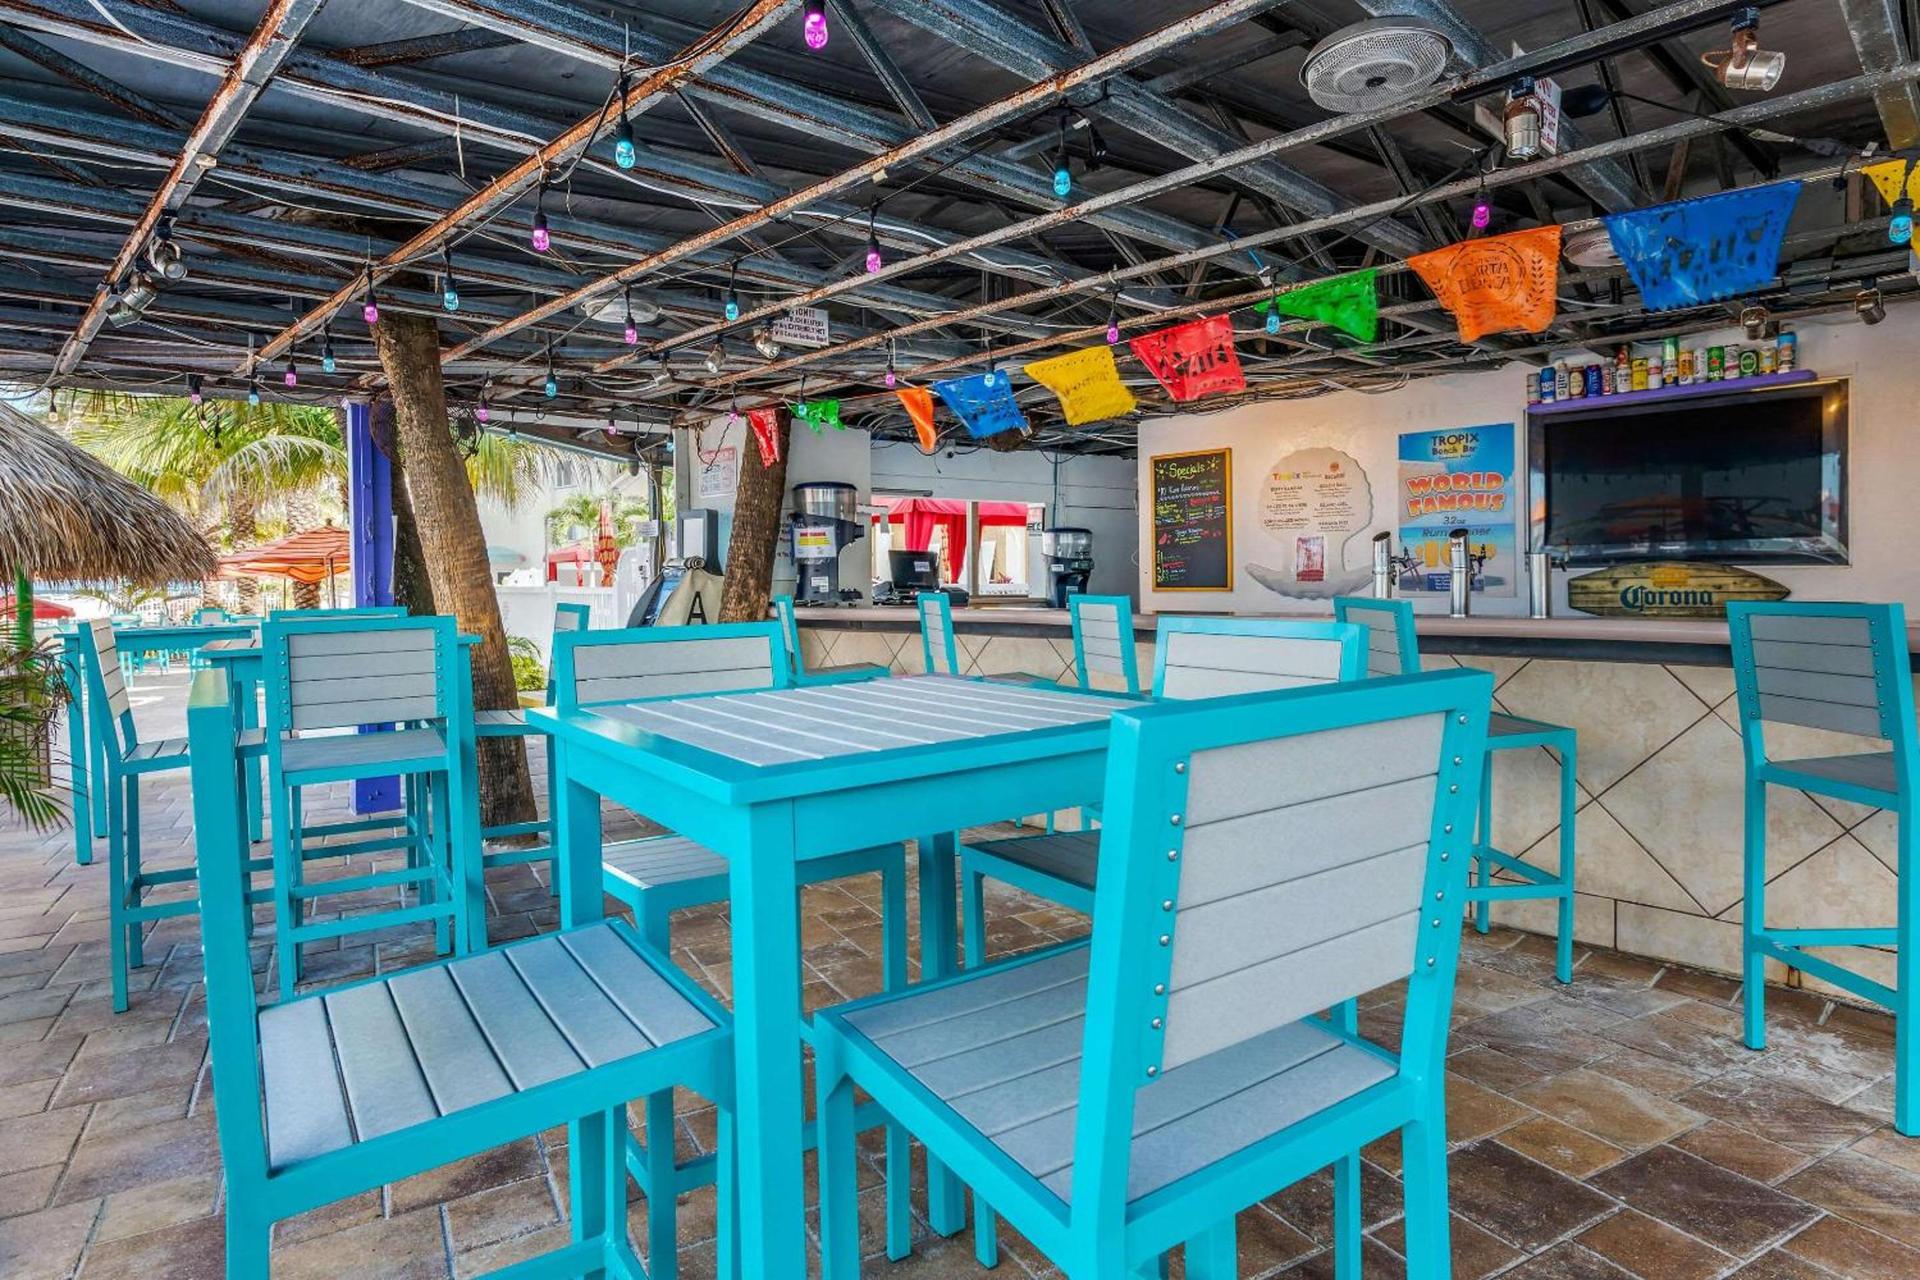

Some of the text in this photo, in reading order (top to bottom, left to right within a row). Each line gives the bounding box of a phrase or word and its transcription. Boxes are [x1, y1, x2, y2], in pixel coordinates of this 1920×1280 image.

[1432, 432, 1480, 446] TROPIX
[1463, 445, 1476, 453] Bar
[1169, 462, 1205, 480] Specials
[1407, 471, 1505, 496] WORLD
[1407, 493, 1505, 517] FAMOUS
[1620, 585, 1714, 611] Corona
